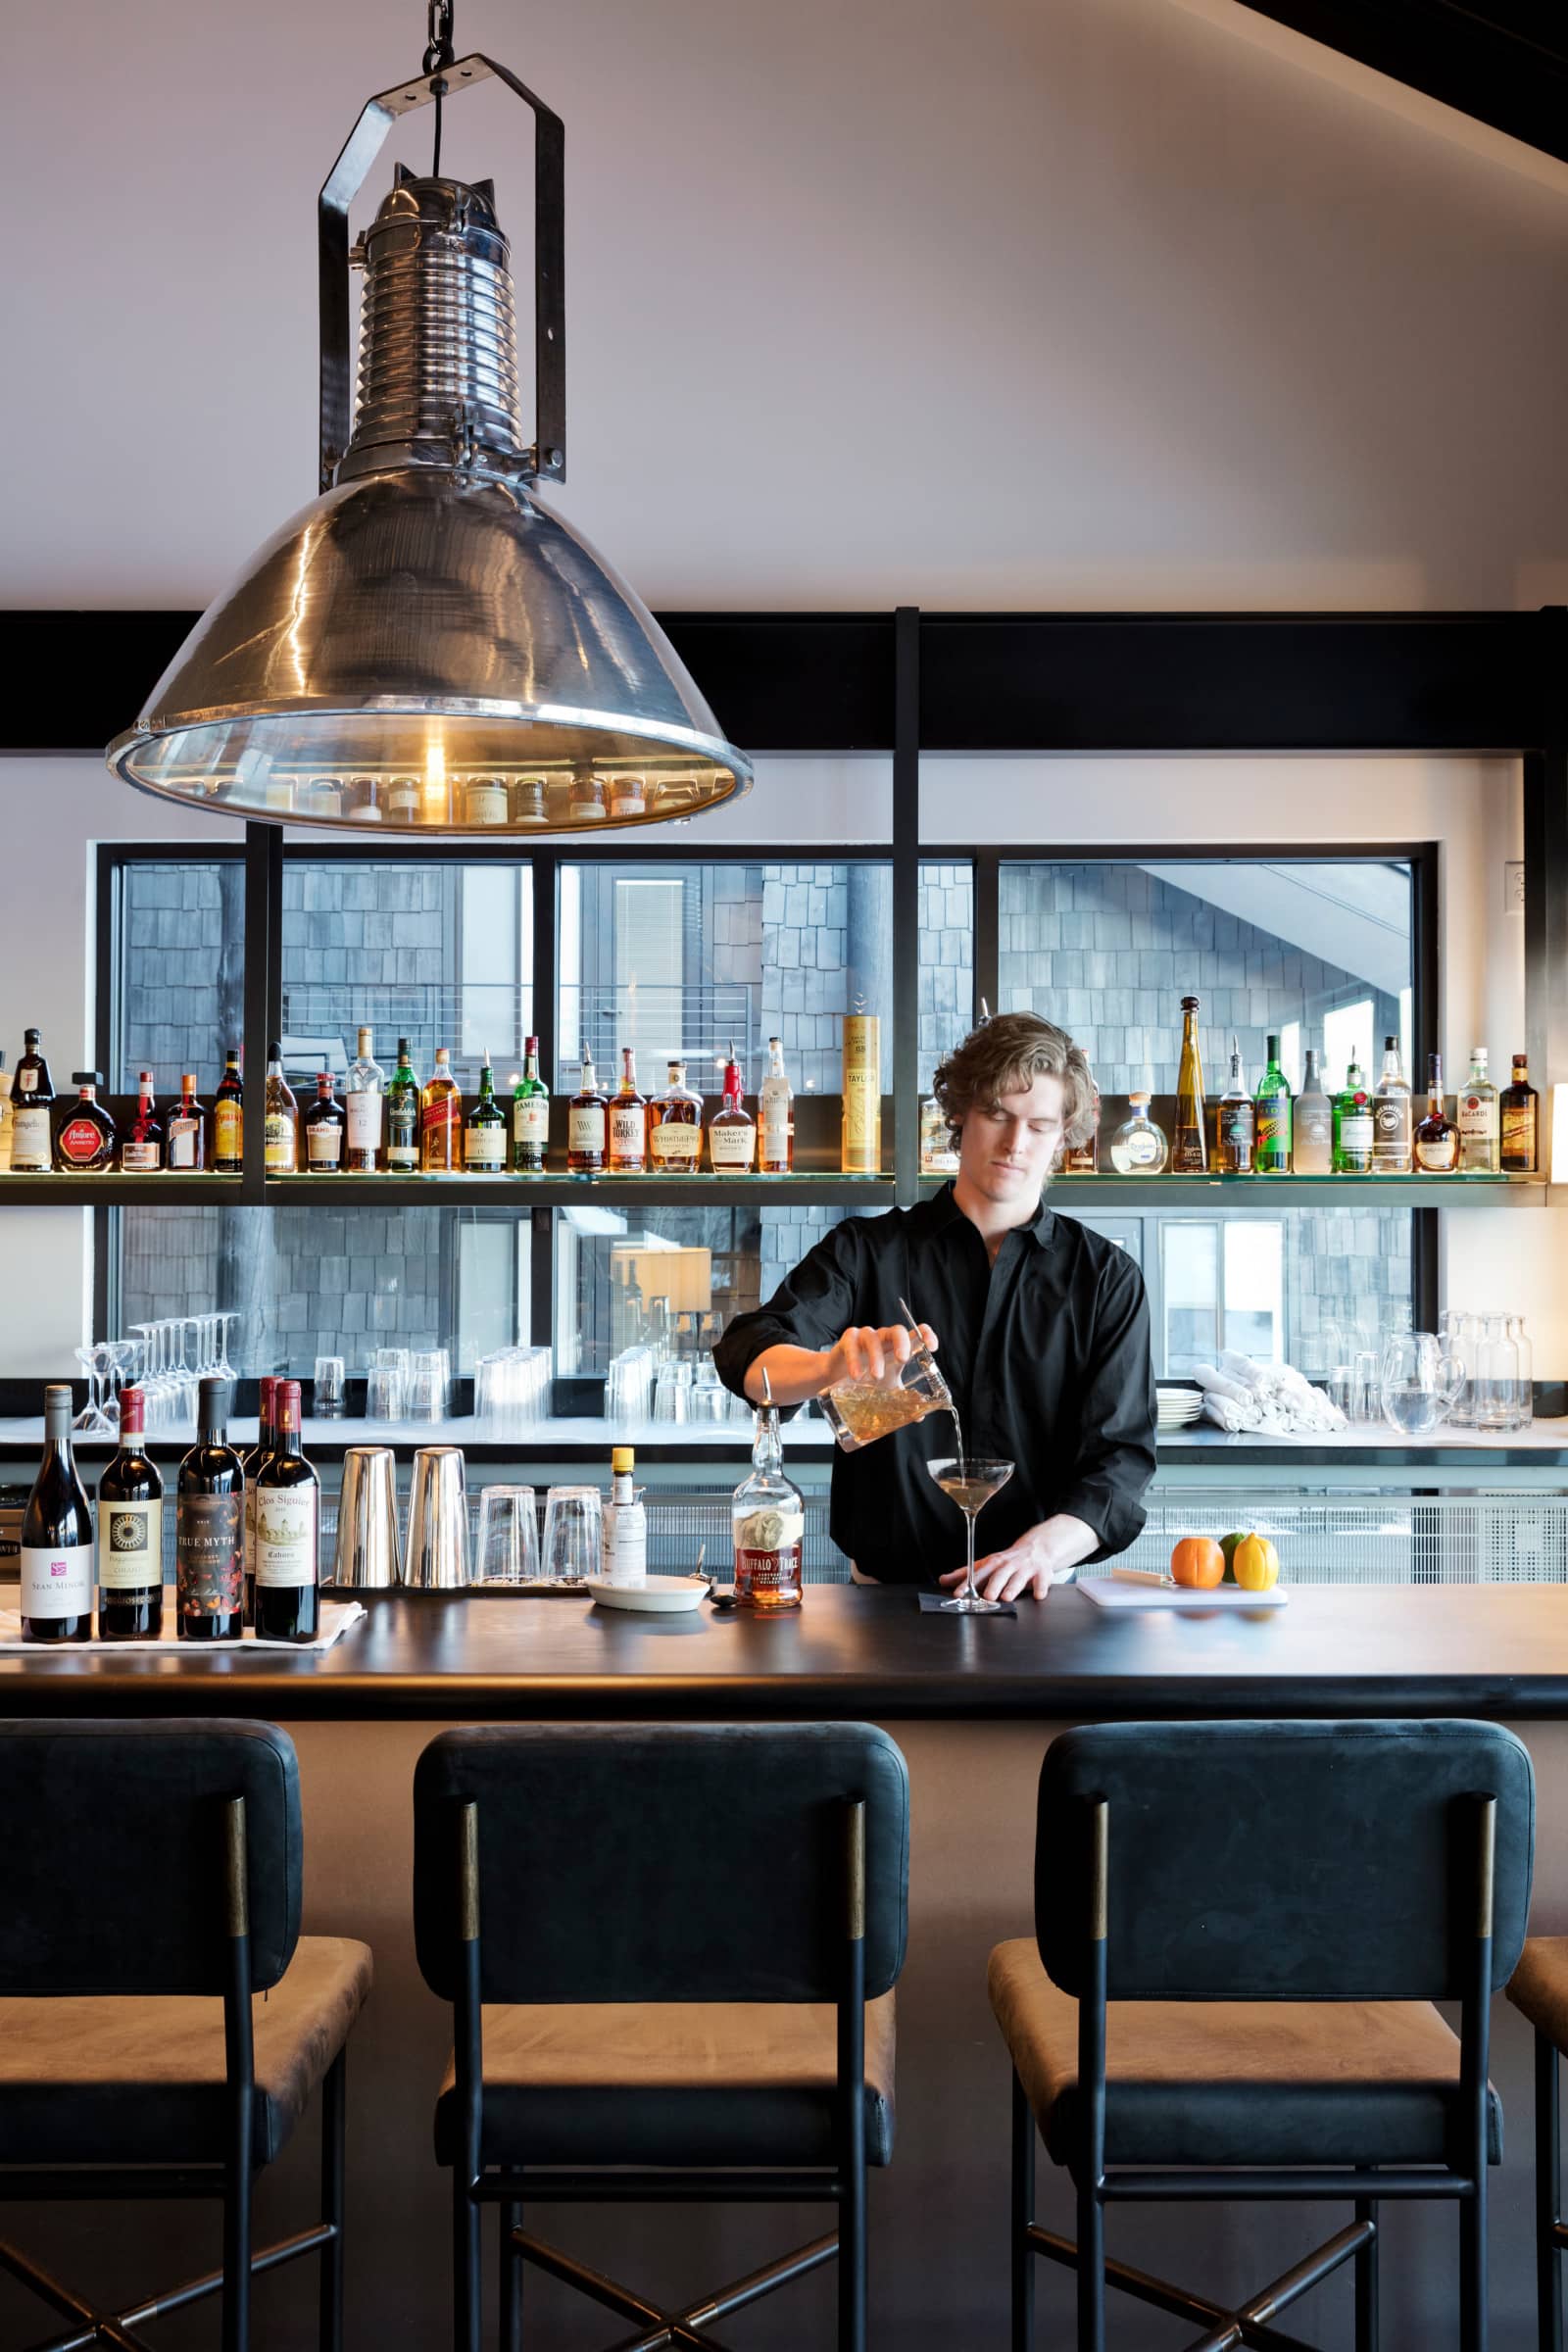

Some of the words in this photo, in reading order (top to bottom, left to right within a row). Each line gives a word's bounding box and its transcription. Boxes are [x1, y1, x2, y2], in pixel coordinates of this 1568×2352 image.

[615, 1119, 636, 1129] WILD
[259, 1496, 274, 1506] Clos
[178, 1536, 201, 1546] TRUE
[204, 1536, 235, 1546] MYTH
[743, 1558, 771, 1571] BUFFALO
[779, 1556, 798, 1570] TRACE
